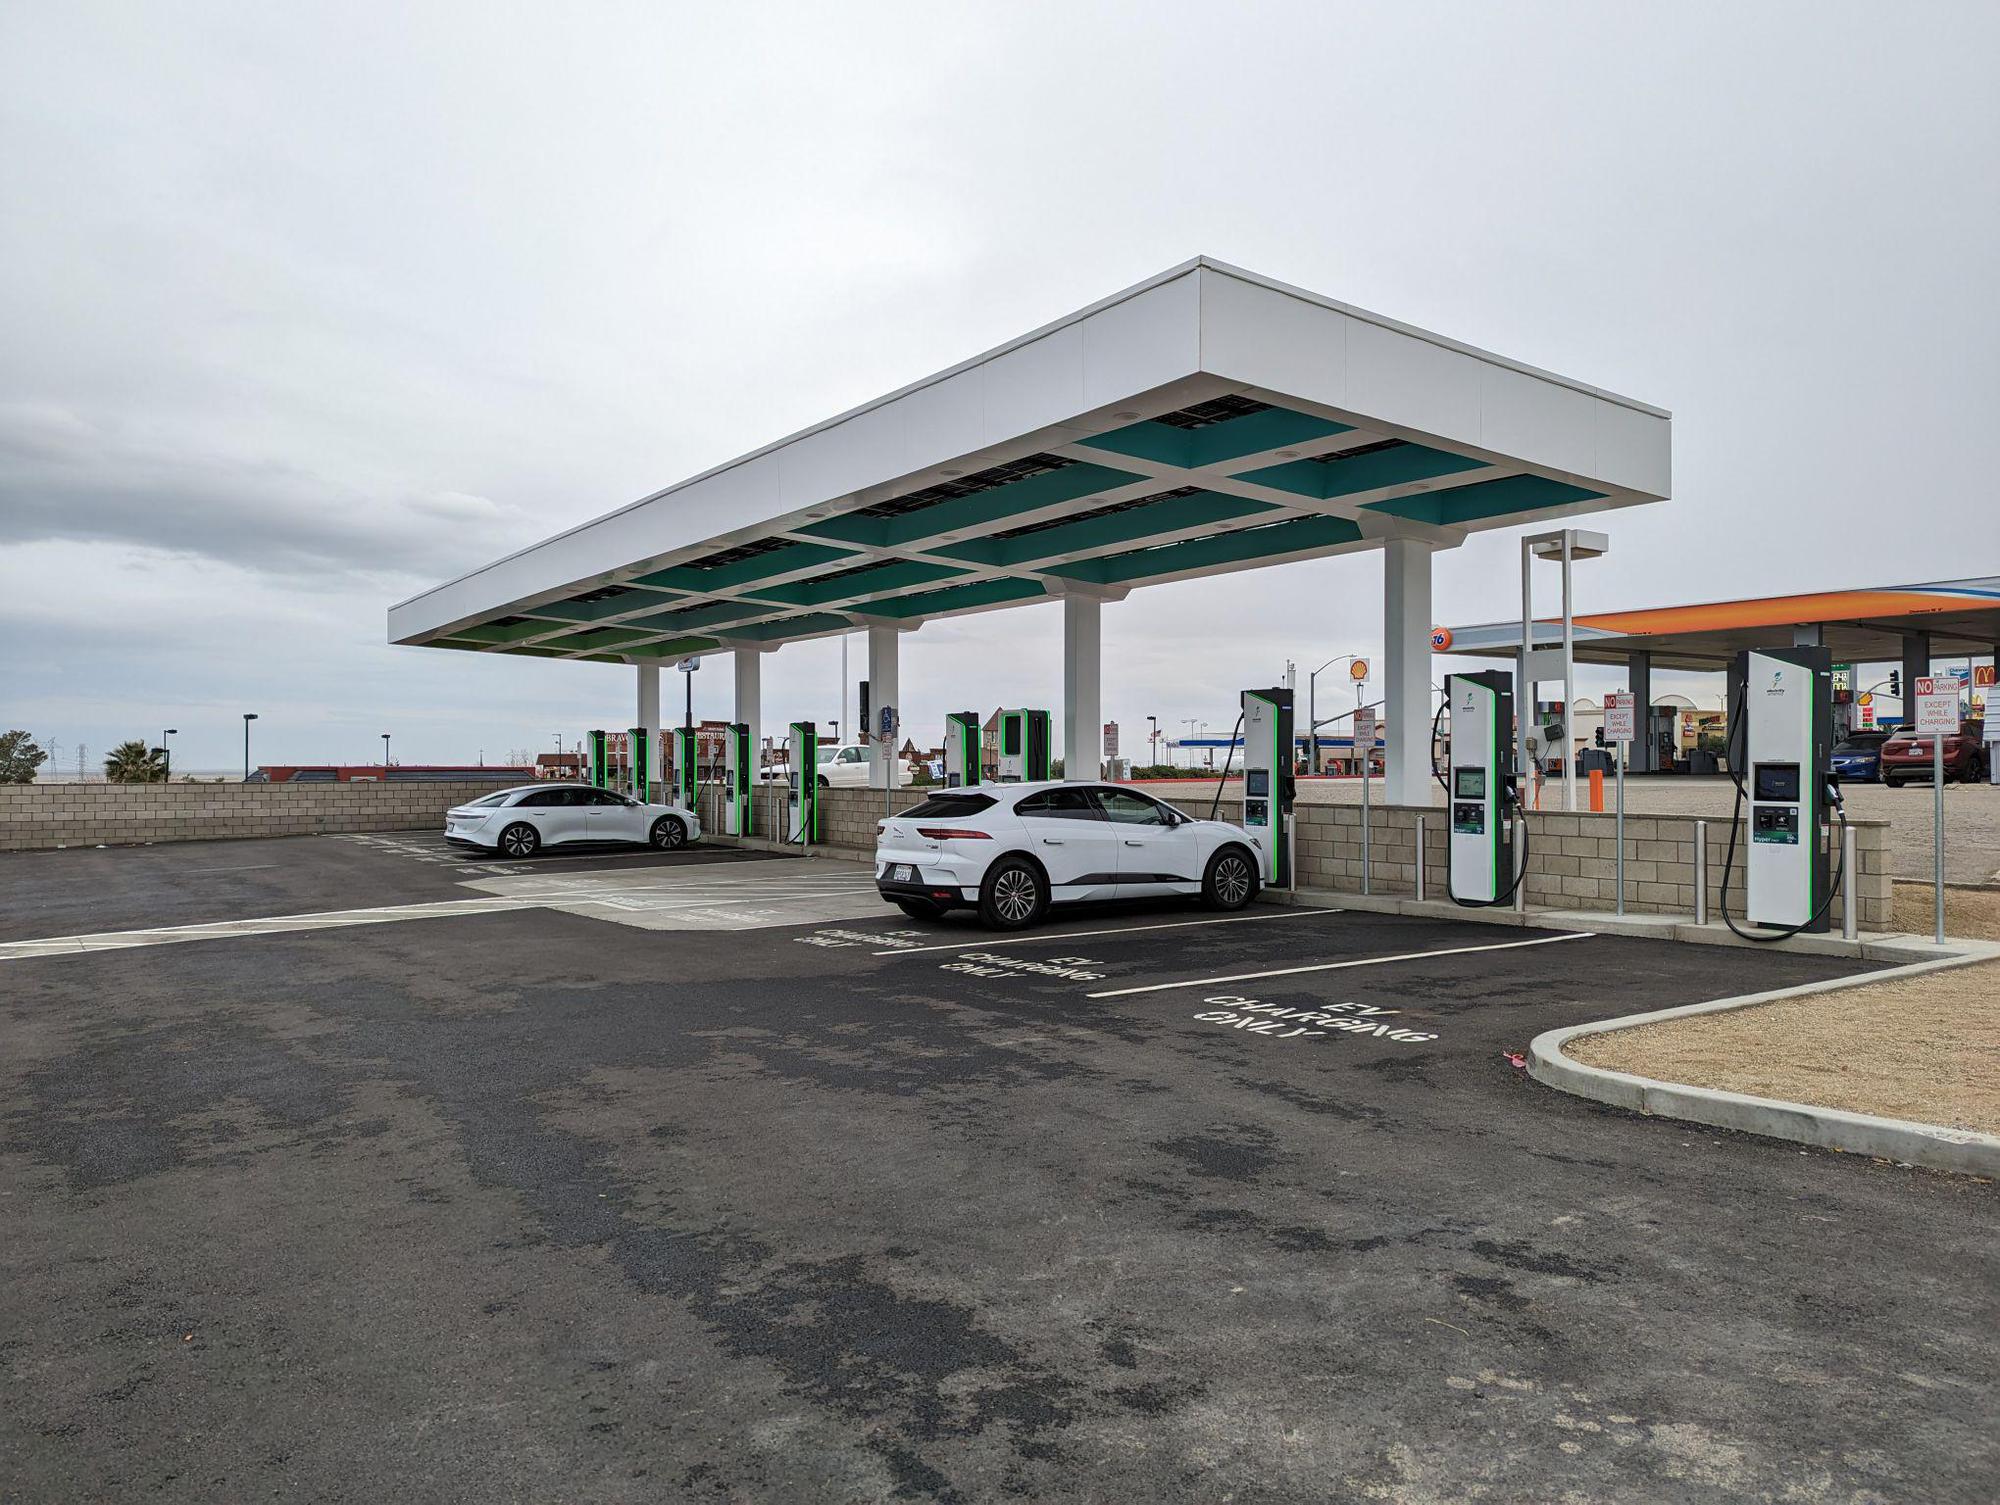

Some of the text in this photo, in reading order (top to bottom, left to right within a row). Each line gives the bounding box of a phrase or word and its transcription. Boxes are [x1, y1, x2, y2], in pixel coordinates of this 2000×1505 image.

[1432, 633, 1444, 645] 76
[1917, 681, 1958, 693] NO PARKING
[1605, 696, 1616, 707] NO
[958, 953, 1107, 980] CHARGING
[1046, 956, 1105, 965] EV
[939, 963, 1028, 978] ONLY
[1320, 1002, 1401, 1016] EV
[1193, 1011, 1328, 1038] ONLY
[1203, 996, 1439, 1042] CHARGING
